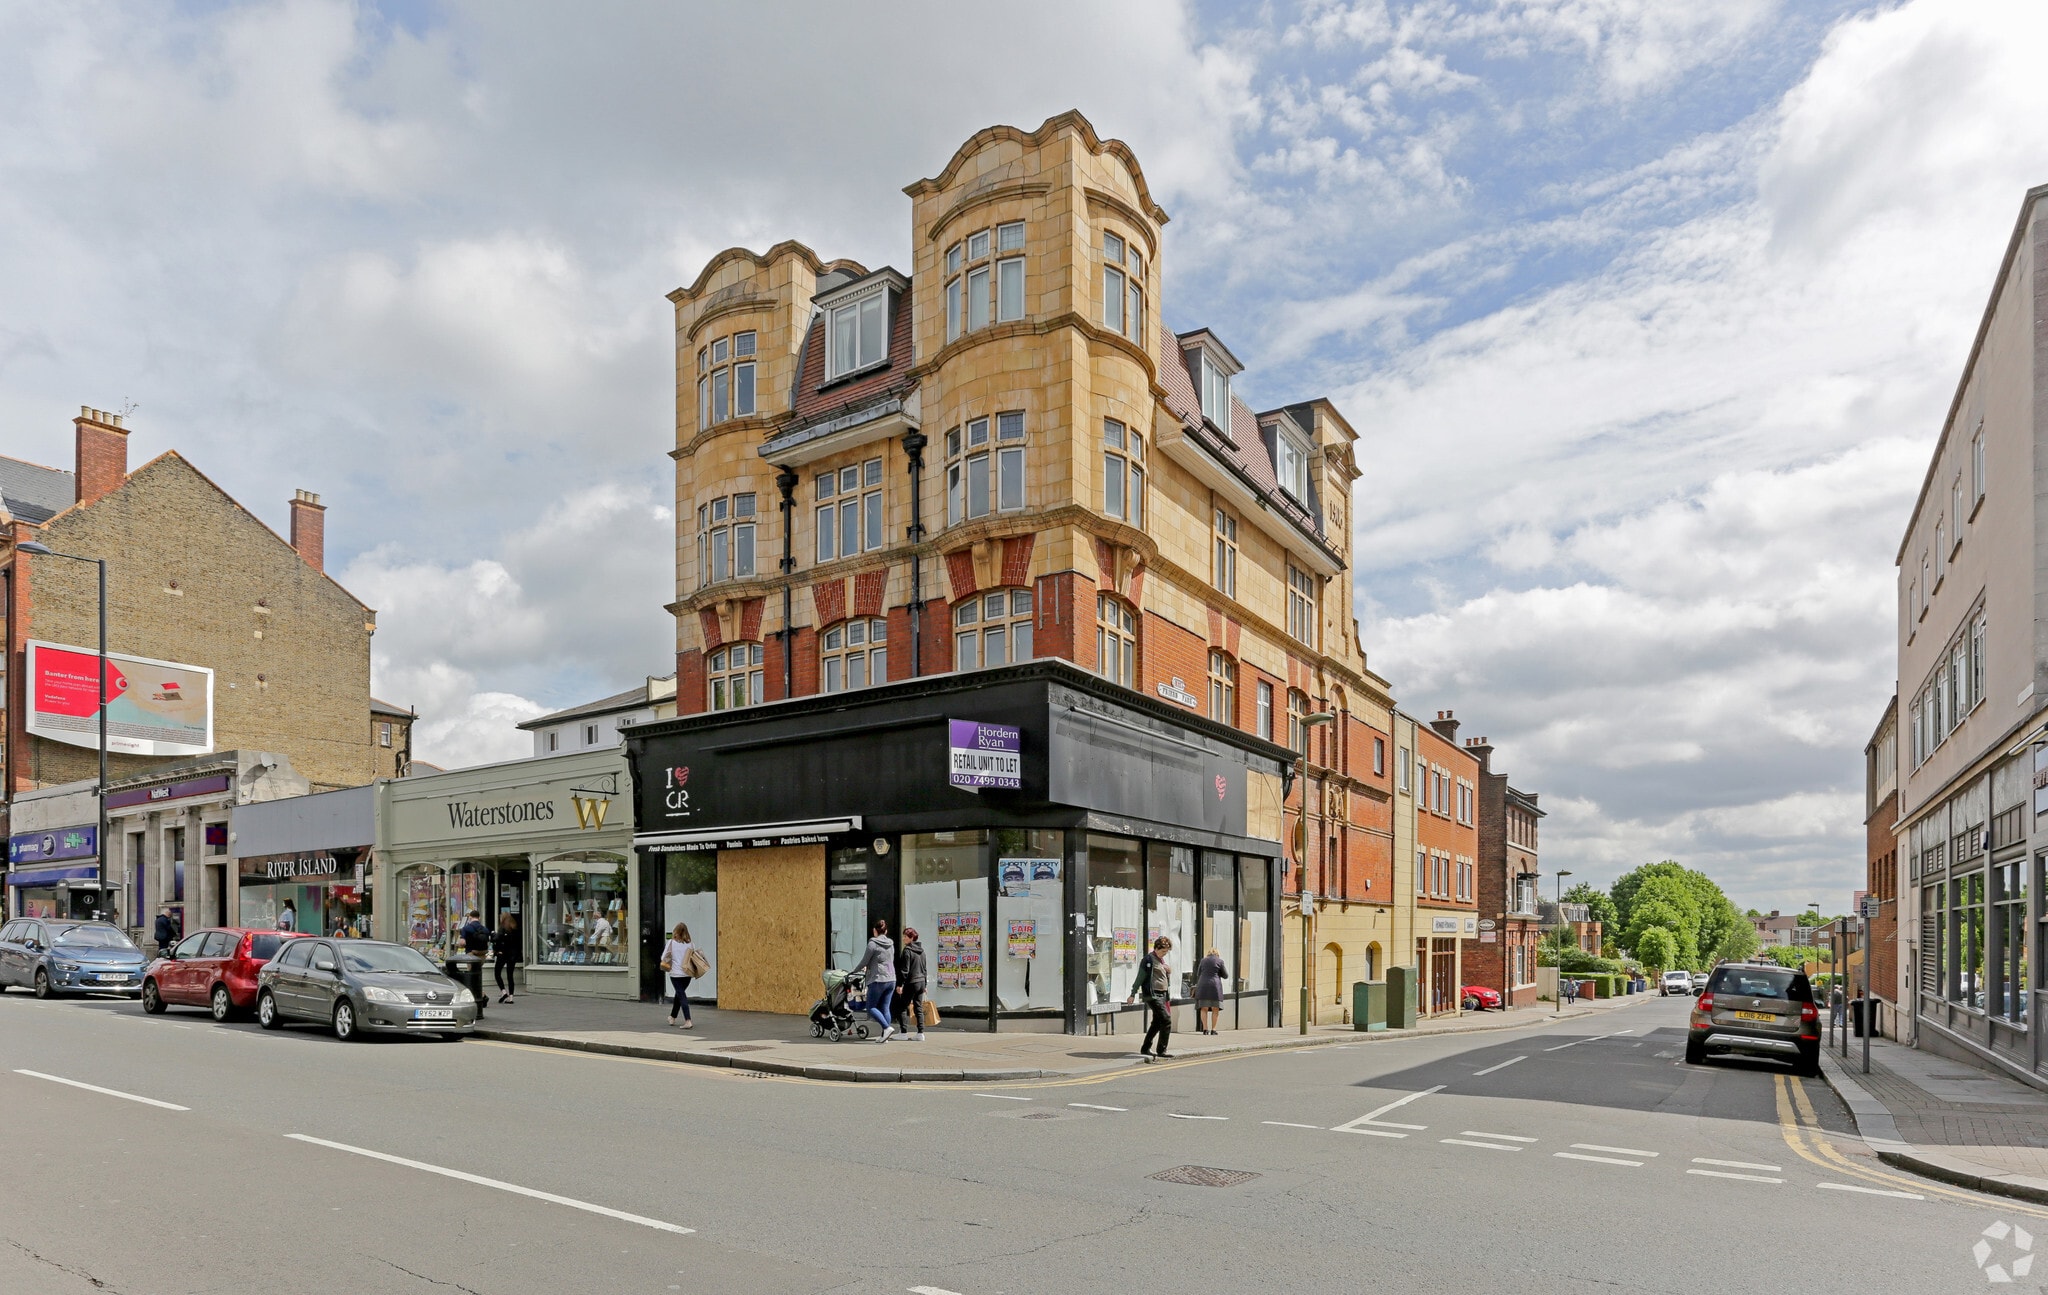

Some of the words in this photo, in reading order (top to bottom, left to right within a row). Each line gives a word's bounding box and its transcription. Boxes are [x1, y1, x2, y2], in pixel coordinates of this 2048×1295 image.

[44, 670, 67, 678] Banter
[978, 726, 1019, 739] Hordern
[978, 735, 1004, 749] Ryan
[953, 753, 977, 770] RETAIL
[978, 755, 994, 771] UNIT
[995, 756, 1005, 773] TO
[1006, 758, 1018, 773] LET
[665, 767, 673, 789] I
[953, 774, 971, 784] 020
[973, 775, 996, 785] 7499
[998, 777, 1020, 788] 0343
[665, 790, 690, 809] CR
[447, 800, 554, 829] Waterstones
[571, 796, 613, 831] W
[18, 843, 39, 854] pharmacy
[660, 844, 686, 852] Sandwiches
[686, 843, 699, 851] Made
[704, 842, 717, 850] Order
[752, 838, 771, 846] Toasties
[780, 836, 801, 845] Pastries
[800, 835, 817, 843] Baked
[817, 834, 829, 842] here
[267, 861, 296, 878] RIVER
[299, 857, 337, 876] ISLAND
[940, 918, 957, 926] FAIR
[961, 917, 979, 925] FAIR
[1011, 925, 1034, 933] FAIR
